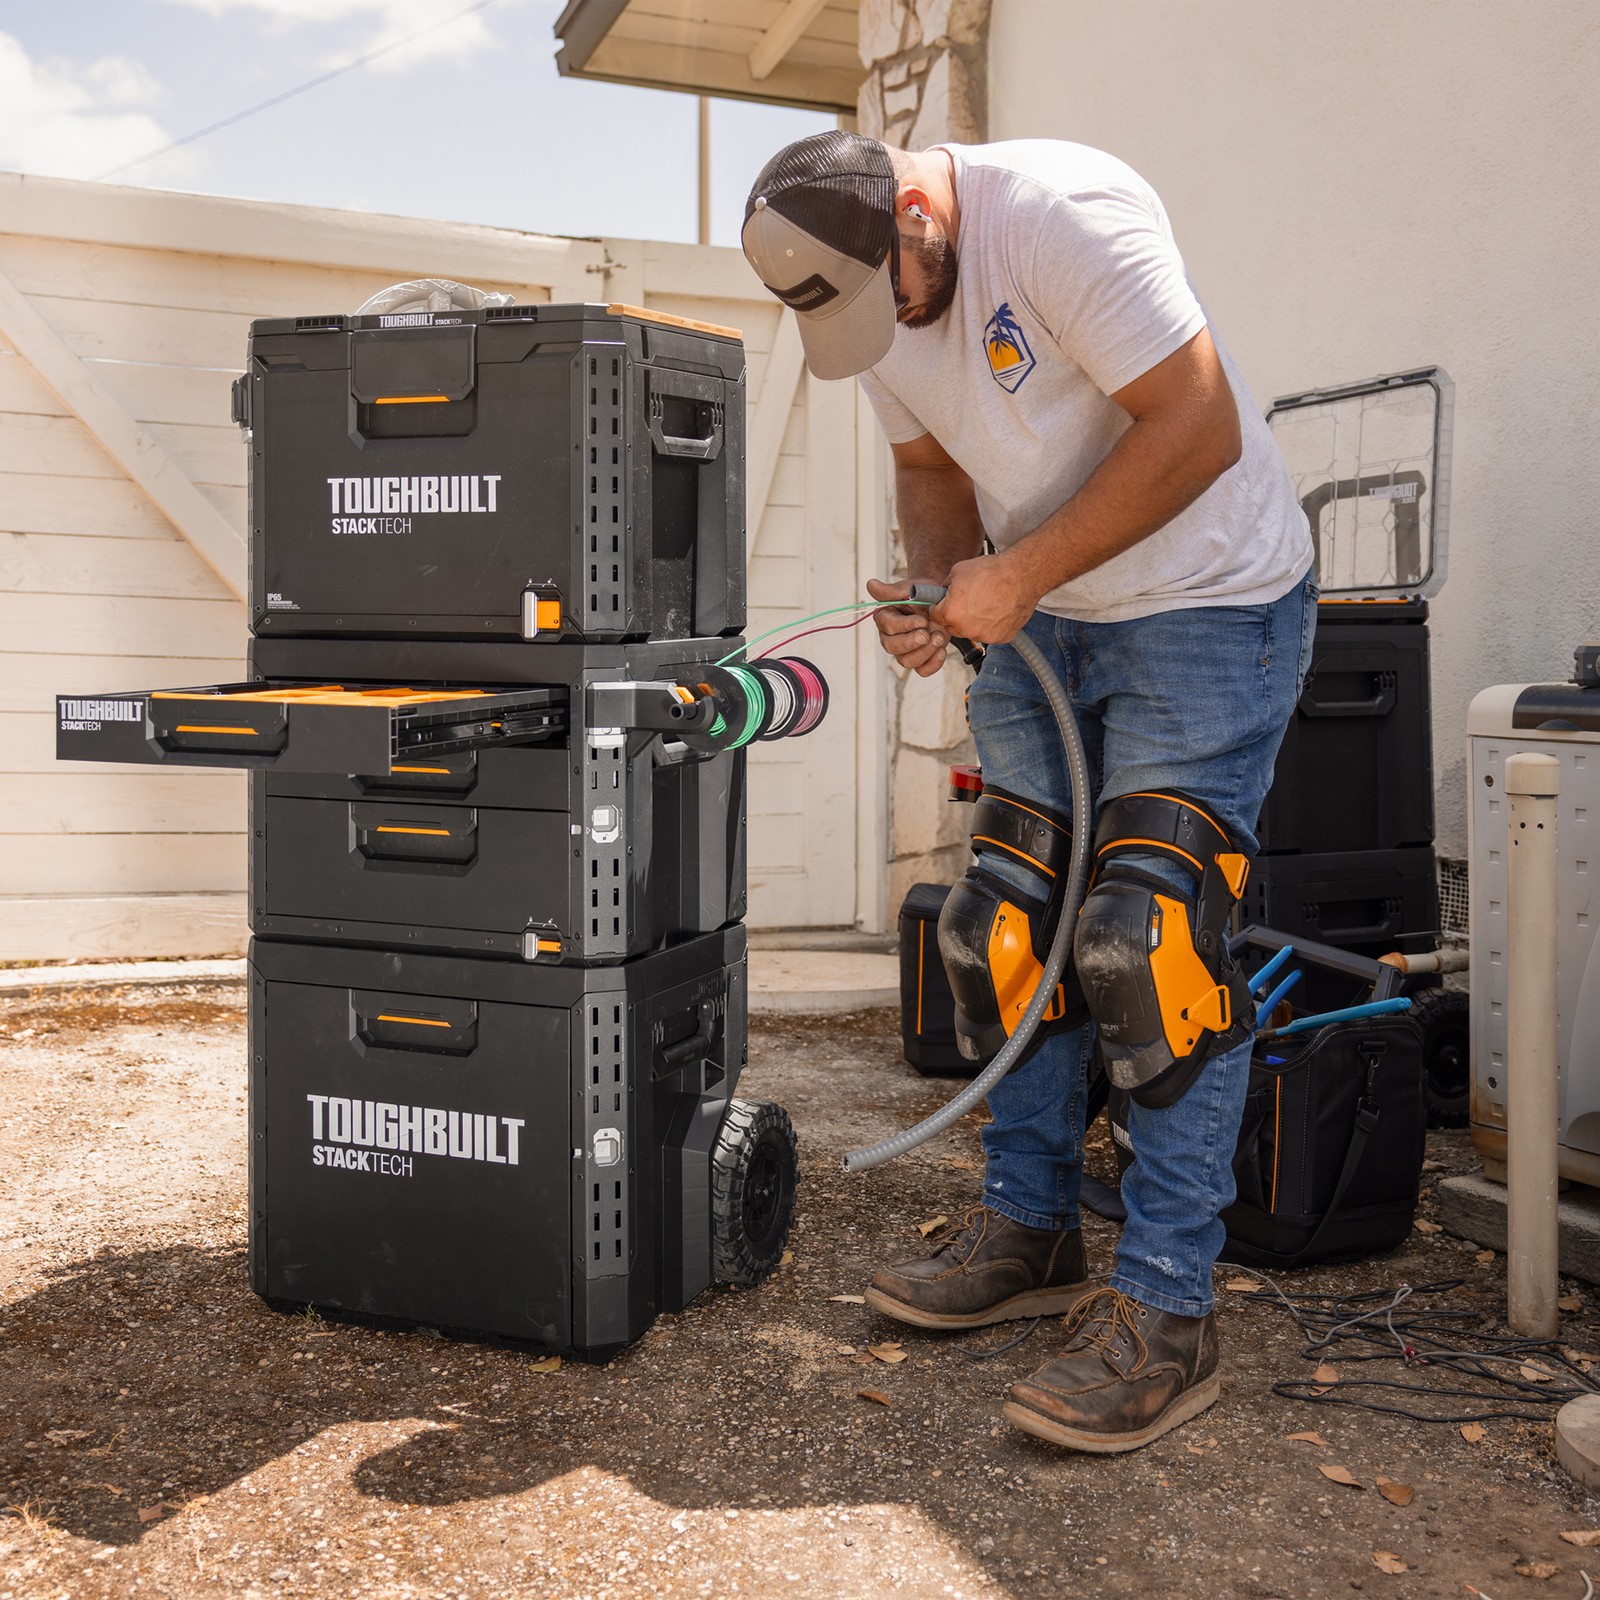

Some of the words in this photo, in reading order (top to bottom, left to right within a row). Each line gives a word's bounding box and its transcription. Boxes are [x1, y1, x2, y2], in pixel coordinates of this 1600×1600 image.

[379, 313, 435, 328] TOUGHBUILT
[435, 318, 463, 326] STACKTECH
[327, 475, 502, 514] TOUGHBUILT
[332, 517, 412, 535] STACKTECH
[267, 593, 282, 601] IP65
[59, 700, 144, 722] TOUGHBUILT
[61, 721, 102, 731] STACKTECH
[307, 1094, 525, 1166] TOUGHBUILT
[312, 1144, 413, 1178] STACKTECH
